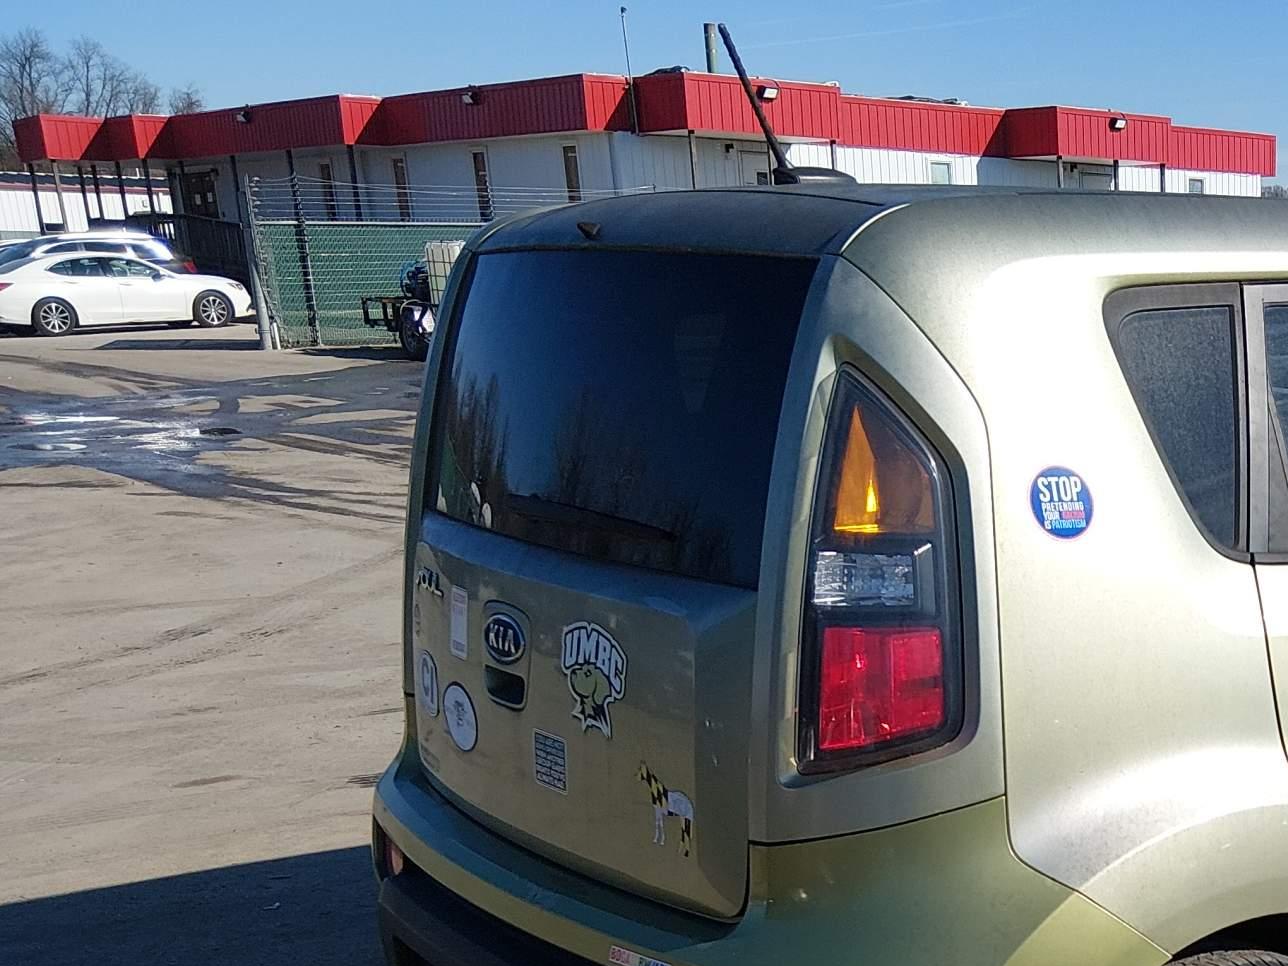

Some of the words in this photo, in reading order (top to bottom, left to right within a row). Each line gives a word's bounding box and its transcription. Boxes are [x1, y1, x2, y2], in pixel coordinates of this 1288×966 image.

[1037, 475, 1082, 502] STOP
[1041, 501, 1084, 512] PRETENDING
[1044, 519, 1052, 530] IS
[1052, 518, 1087, 529] PATRIOTISM
[488, 623, 516, 653] KIA
[565, 628, 623, 695] UMBC
